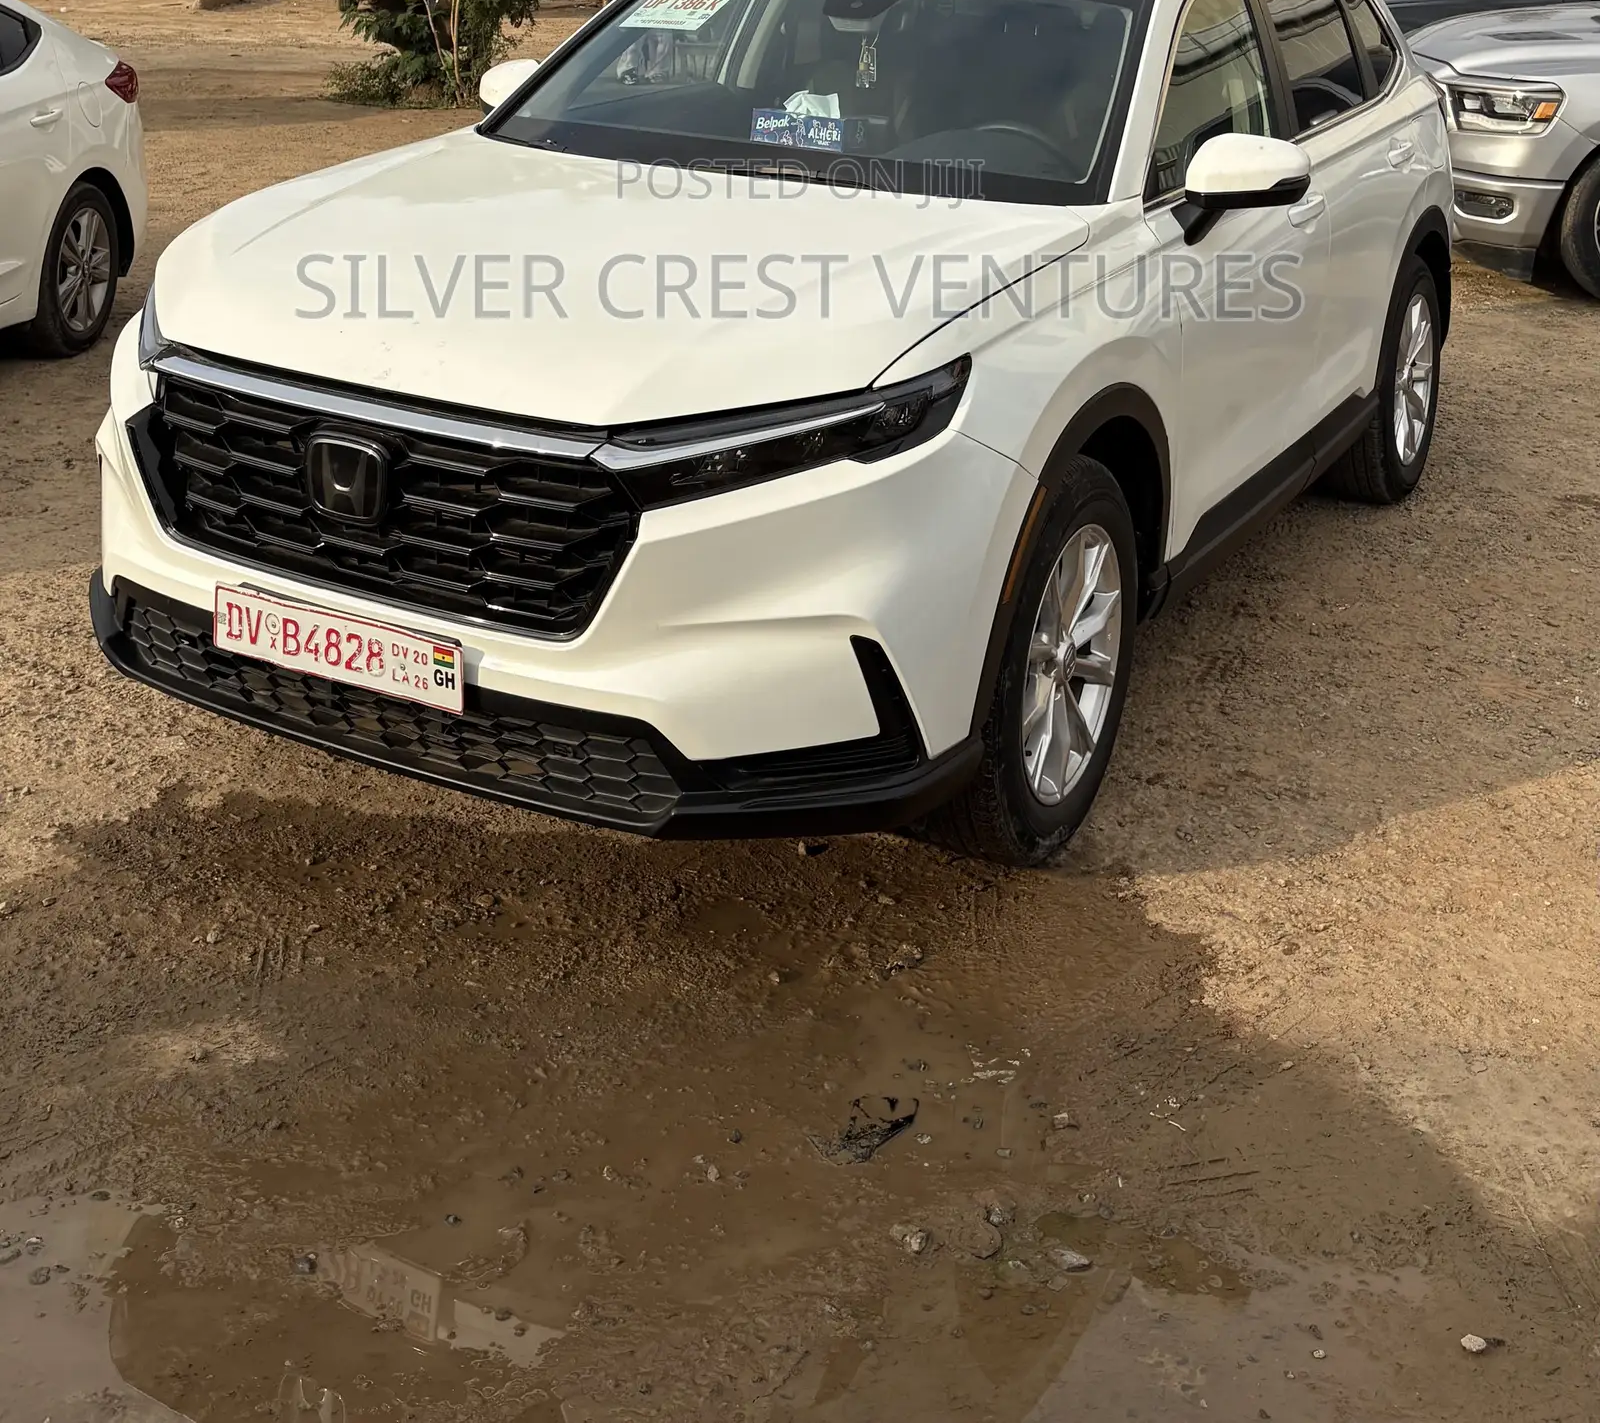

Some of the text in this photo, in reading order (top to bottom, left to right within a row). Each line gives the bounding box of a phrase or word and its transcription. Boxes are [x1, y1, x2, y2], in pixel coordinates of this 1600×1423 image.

[756, 115, 791, 131] Belpak
[226, 601, 386, 677] DV B4828
[392, 642, 428, 665] DV 20
[392, 668, 429, 690] LA 26
[433, 669, 455, 690] GH
